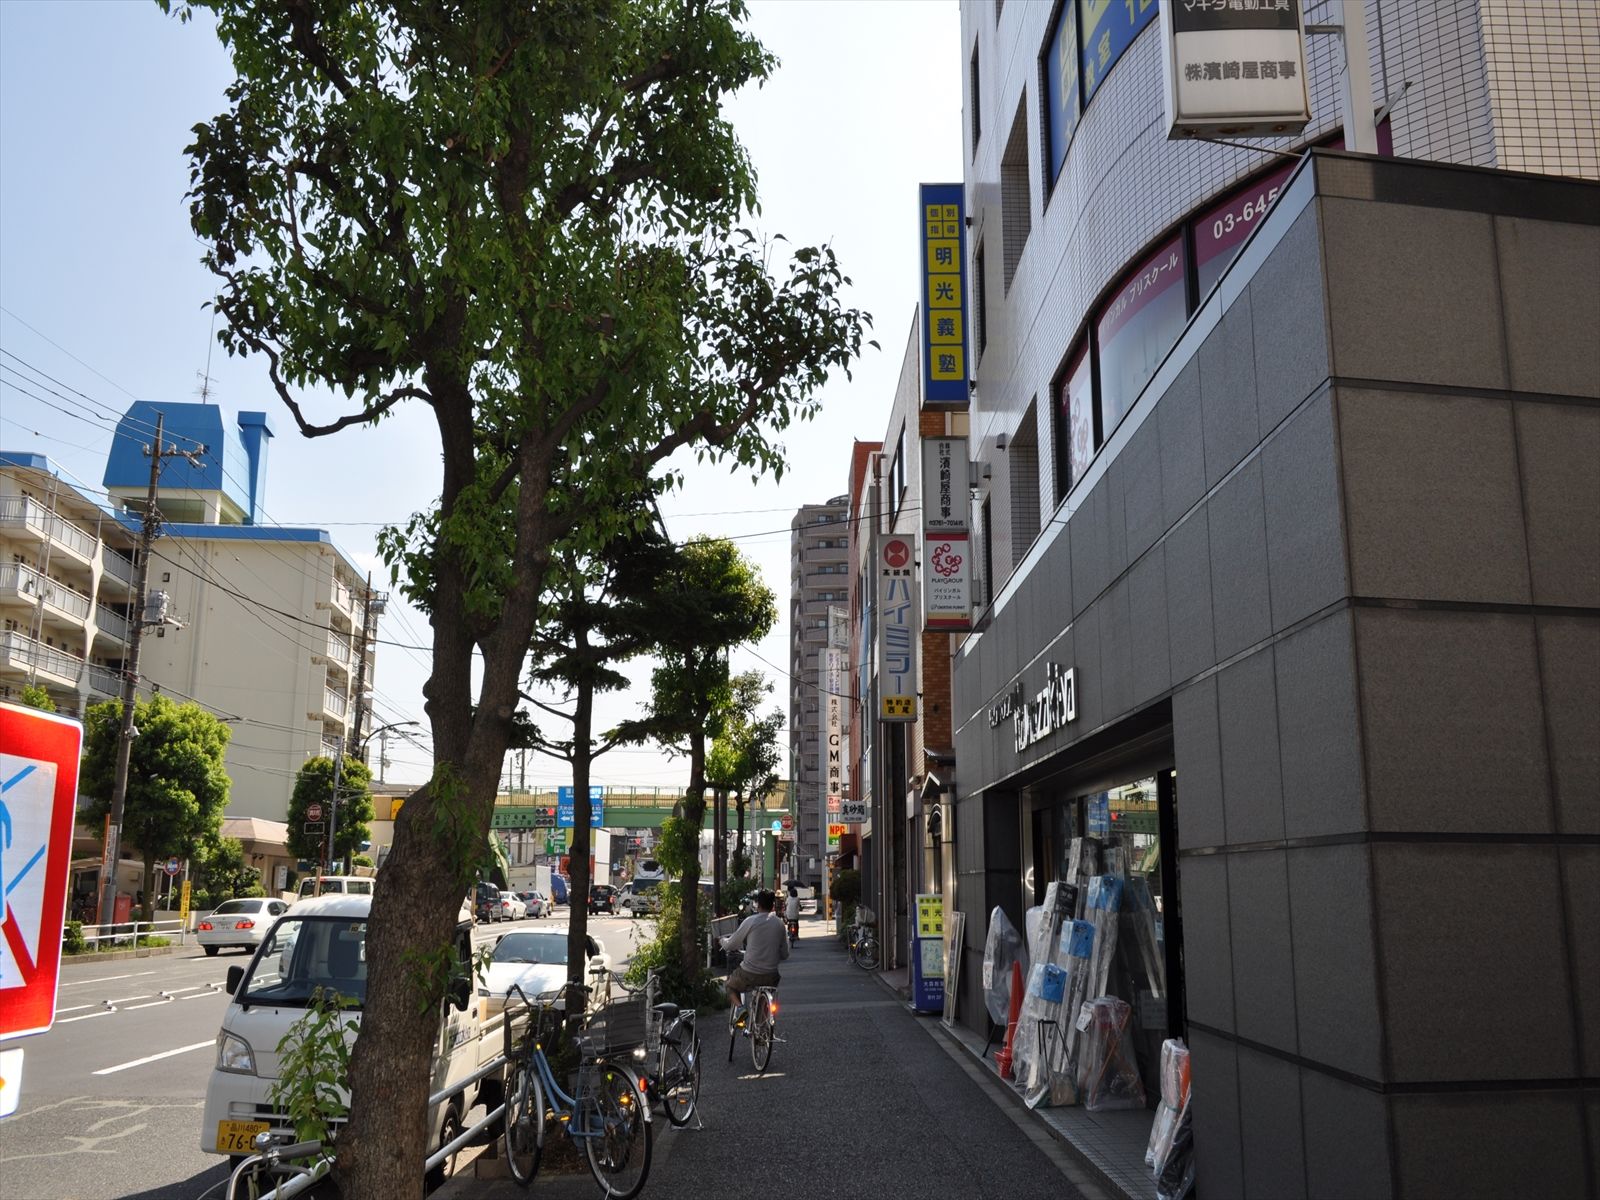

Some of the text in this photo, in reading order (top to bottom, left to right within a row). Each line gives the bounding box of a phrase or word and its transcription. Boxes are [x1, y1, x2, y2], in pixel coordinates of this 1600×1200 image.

[1213, 183, 1285, 239] 03-645
[1129, 253, 1179, 302] プリスクール
[935, 246, 957, 373] 明光義塾
[884, 579, 911, 694] ハイミラー
[829, 825, 845, 835] NPC
[228, 1133, 257, 1150] 76-0
